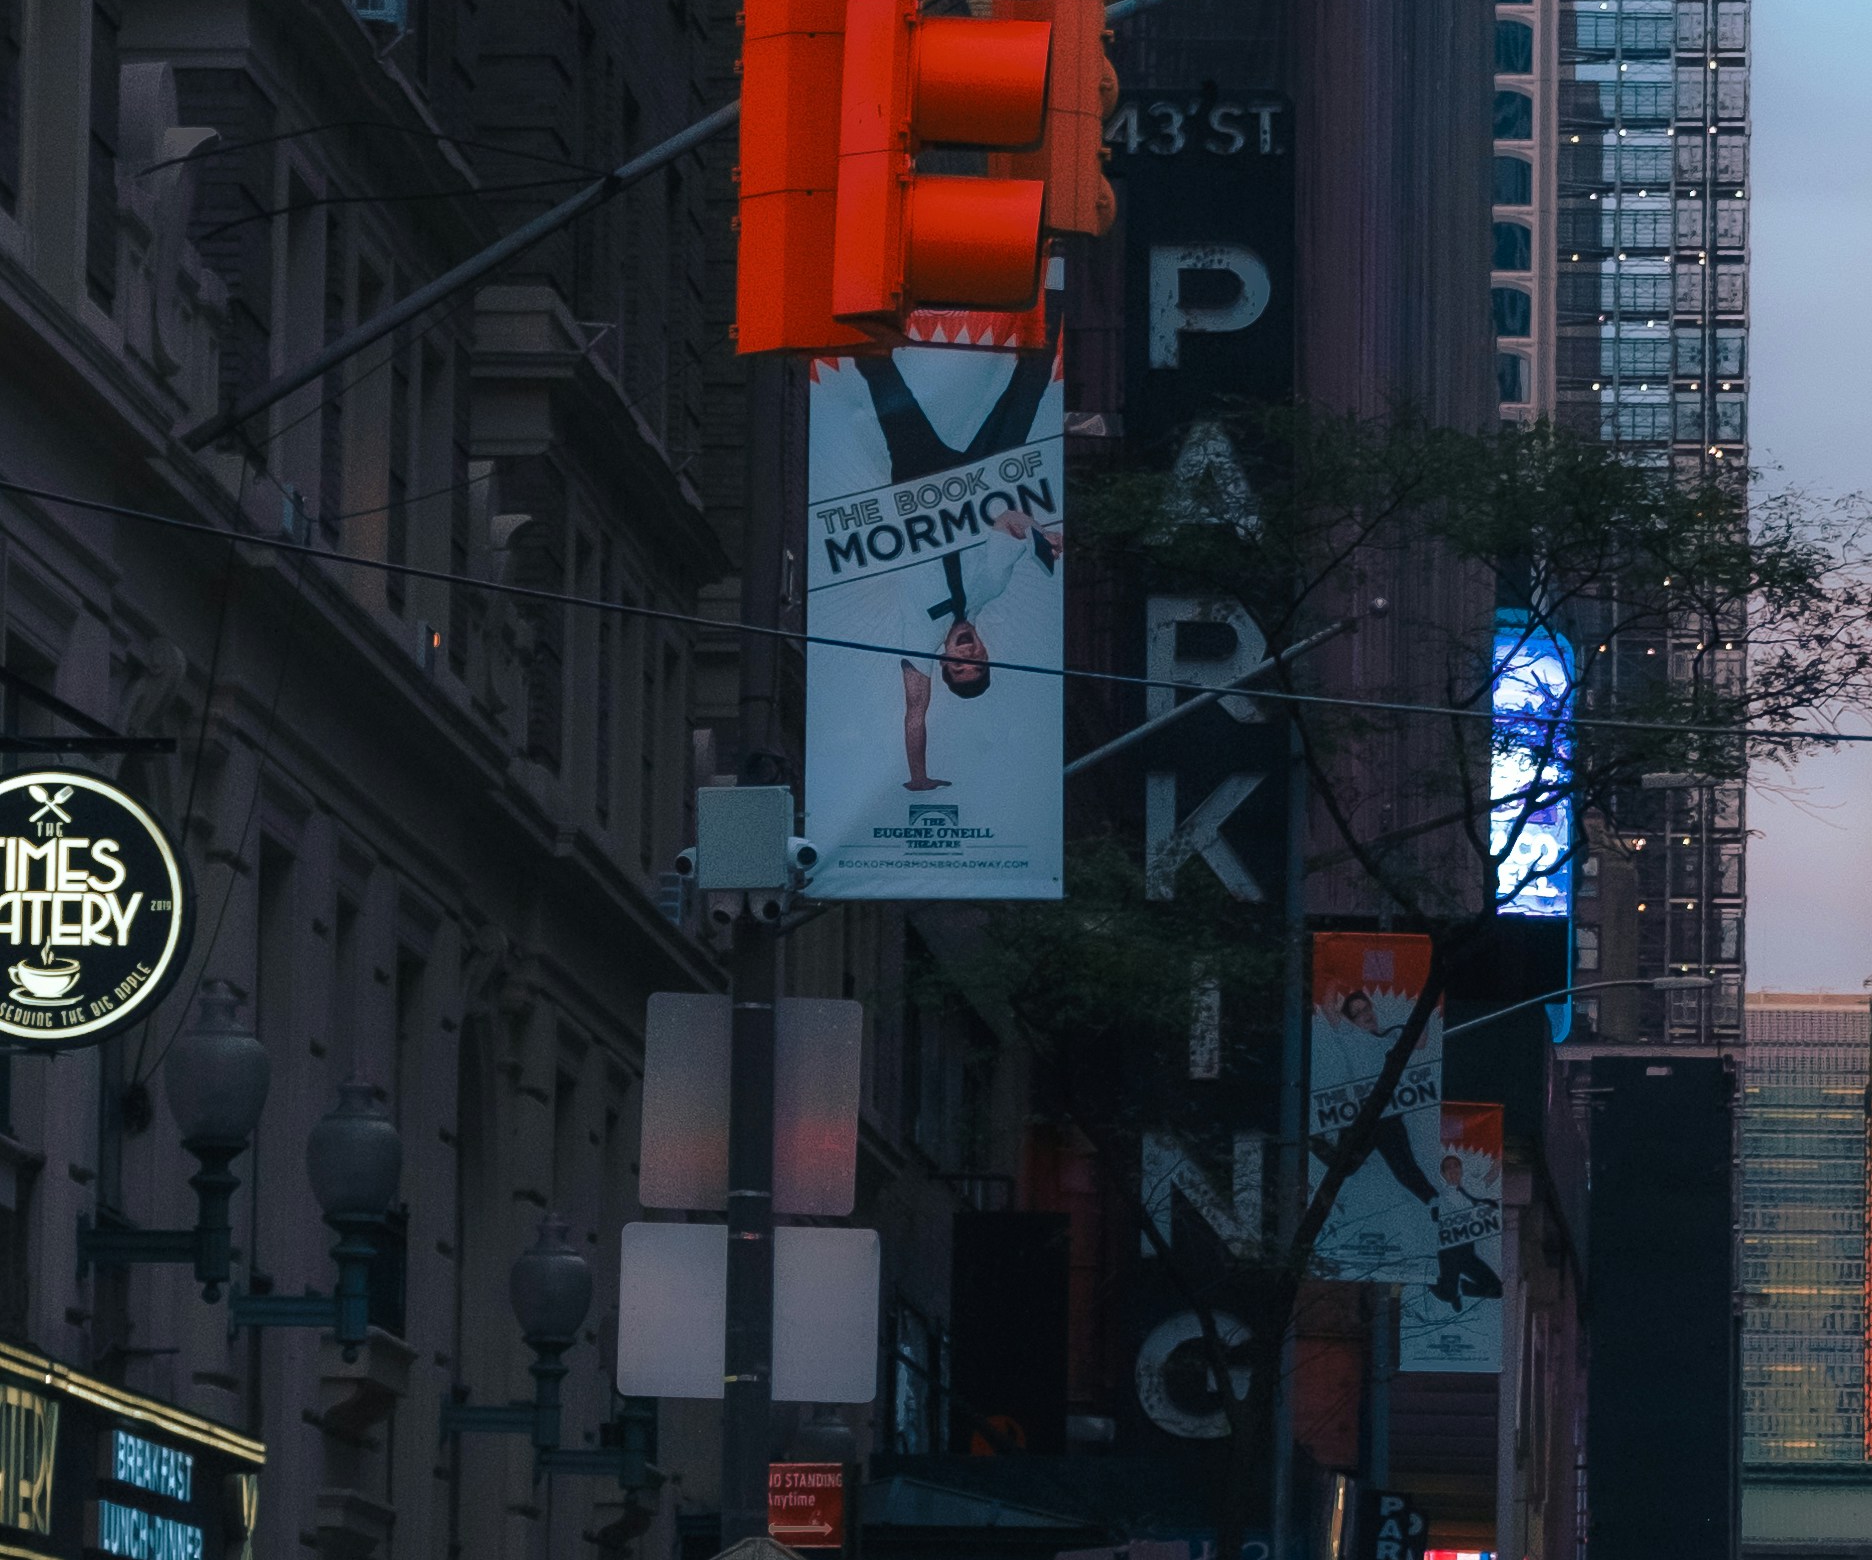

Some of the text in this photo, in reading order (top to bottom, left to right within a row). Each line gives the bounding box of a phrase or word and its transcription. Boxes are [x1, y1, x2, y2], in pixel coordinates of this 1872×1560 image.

[817, 450, 1044, 535] THE BOOK OF
[824, 477, 1057, 575] MORMON
[873, 827, 934, 839] EUGENE
[906, 839, 961, 849] THEATRE
[1134, 243, 1271, 1440] PARKING
[117, 1429, 194, 1504] BREAKFAST
[785, 1472, 843, 1488] STANDING
